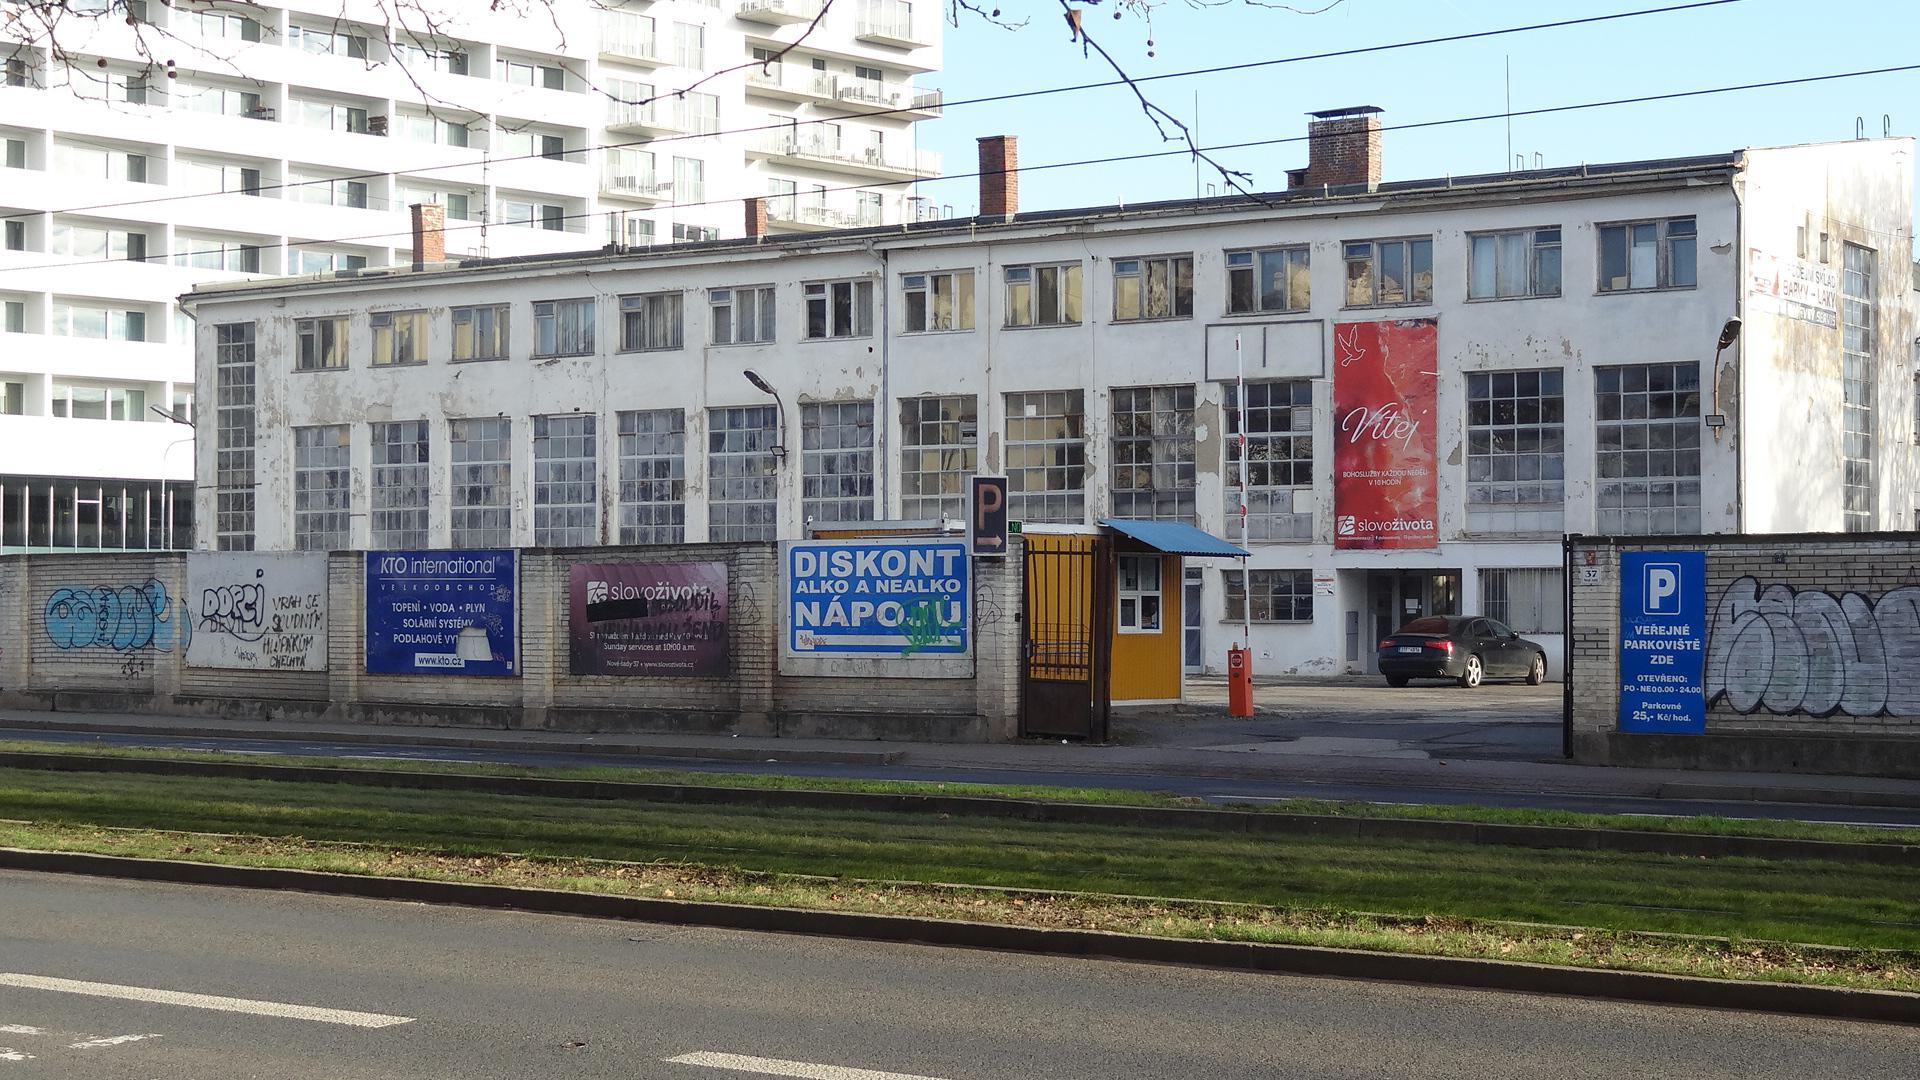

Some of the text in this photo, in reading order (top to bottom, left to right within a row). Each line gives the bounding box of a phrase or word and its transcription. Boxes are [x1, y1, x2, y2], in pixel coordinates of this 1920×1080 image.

[1817, 287, 1836, 309] LAKY
[1343, 470, 1380, 478] BOHOSLUŽBY
[1381, 469, 1406, 478] KAŽDOU
[979, 484, 1002, 529] P
[1358, 518, 1433, 531] slovoživota
[380, 557, 495, 573] KTO international
[795, 549, 960, 577] DISKONT
[1585, 570, 1597, 578] 37
[611, 581, 708, 601] slovoživota
[796, 578, 961, 594] ALKO A NEALKO
[1650, 569, 1676, 609] P
[272, 594, 321, 611] VRAH SE
[392, 601, 486, 612] TOPENÍ VODA PLYN
[795, 595, 961, 627] NÁPOJŮ
[403, 616, 437, 628] SOLÁRNÍ
[438, 617, 474, 628] SYSTÉMY
[1634, 624, 1690, 635] VEŘEJNÉ
[393, 632, 442, 644] PODLAHOVÉ
[1623, 638, 1701, 650] PARKOVIŠTĚ
[604, 643, 627, 652] Sunday
[628, 643, 653, 651] services
[663, 643, 681, 651] 10:00
[418, 655, 462, 667] www.kto.cz
[1650, 655, 1674, 665] ZDE
[1637, 674, 1688, 683] OTEVŘENO:
[1642, 701, 1682, 710] Parkovné
[1632, 711, 1654, 721] 25,-
